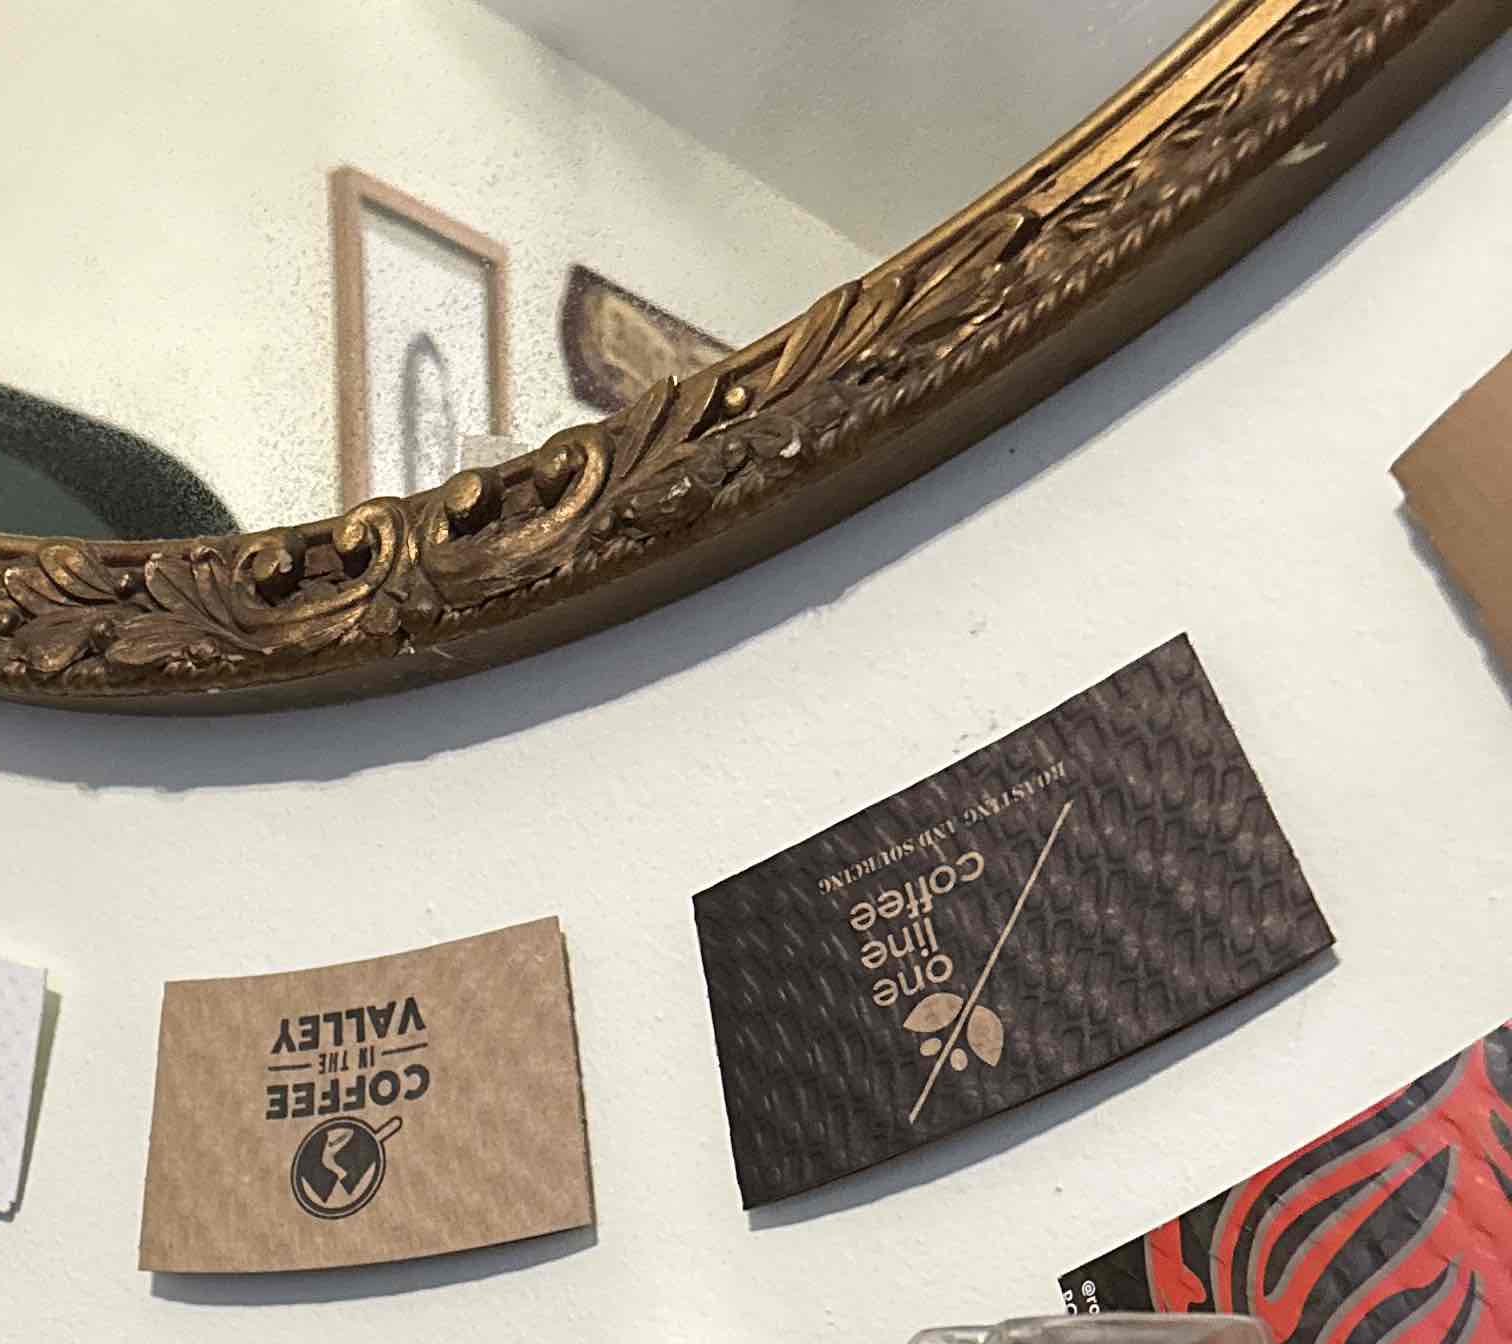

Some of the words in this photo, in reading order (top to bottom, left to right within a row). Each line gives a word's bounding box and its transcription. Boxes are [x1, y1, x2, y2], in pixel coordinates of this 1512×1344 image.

[962, 760, 1066, 827] ROASTING
[918, 818, 956, 849] AND
[817, 837, 916, 897] SOURCING
[849, 850, 985, 932] coffee
[859, 916, 939, 969] line
[871, 953, 954, 1007] one
[270, 996, 427, 1055] VALLEY
[318, 1051, 349, 1075] THE
[357, 1045, 376, 1070] IN
[265, 1063, 431, 1121] COFFEE
